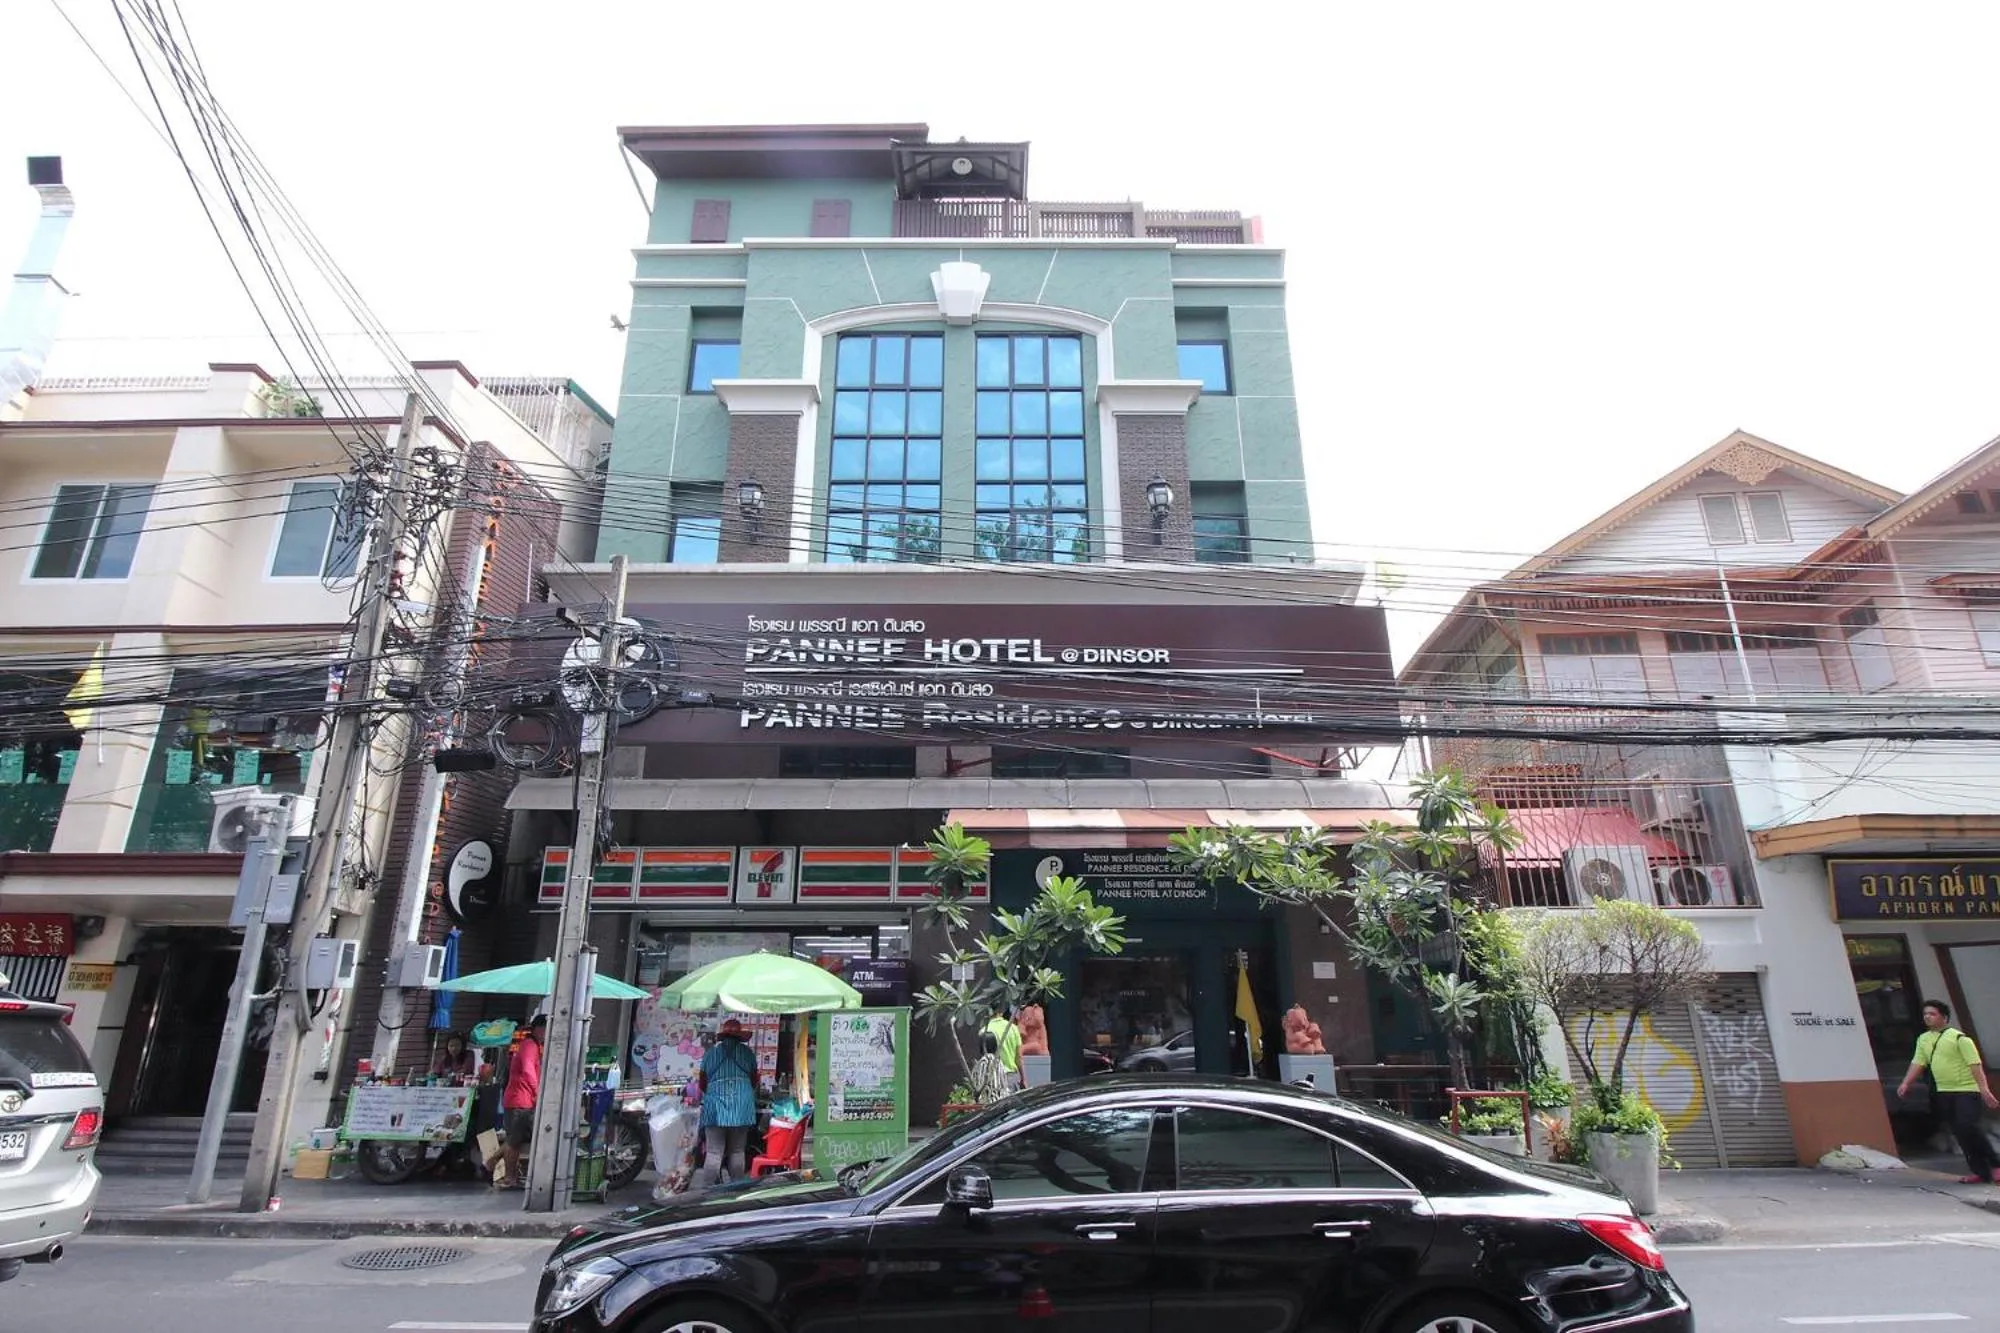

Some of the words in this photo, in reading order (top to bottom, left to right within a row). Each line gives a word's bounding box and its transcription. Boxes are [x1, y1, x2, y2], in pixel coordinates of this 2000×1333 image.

[748, 615, 794, 633] โรงแรม
[799, 617, 847, 632] พรรณี
[852, 618, 879, 632] แอท
[884, 617, 926, 632] ดินสอ
[745, 638, 906, 662] PANNEE
[924, 638, 1055, 662] HOTEL
[1083, 648, 1170, 663] DINSOR
[740, 703, 905, 728] PANNEE
[1087, 864, 1122, 872] PANNEE
[1123, 864, 1170, 872] RESIDENCE
[1096, 889, 1132, 898] PANNEE
[1132, 889, 1161, 898] HOTEL
[1879, 901, 1955, 914] APHORN
[853, 971, 875, 980] ATM
